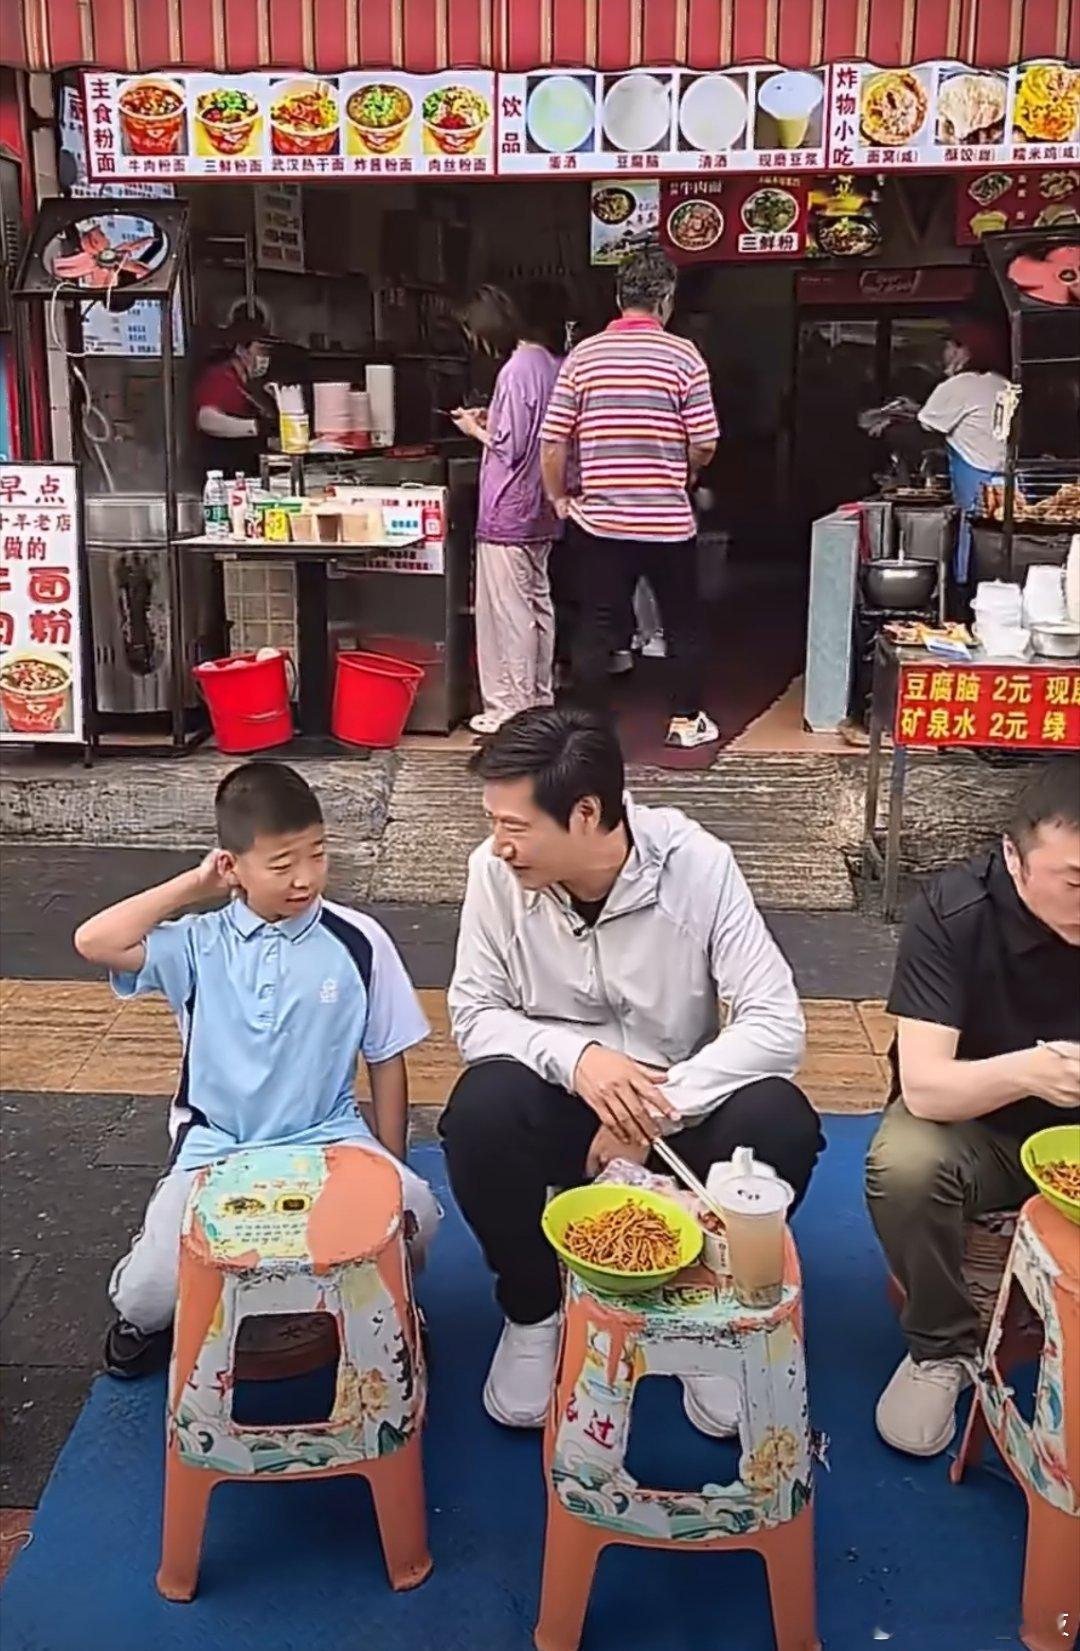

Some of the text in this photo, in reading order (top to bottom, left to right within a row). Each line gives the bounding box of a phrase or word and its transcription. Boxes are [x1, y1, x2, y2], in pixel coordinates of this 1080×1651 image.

[833, 67, 858, 166] 炸物小吃
[90, 78, 116, 174] 主食粉面
[501, 96, 522, 154] 饮品
[128, 158, 186, 173] 牛肉粉面
[204, 158, 263, 174] 三鲜粉面
[271, 157, 345, 172] 武汉热干面
[353, 157, 413, 173] 炸酱粉面
[428, 157, 488, 173] 肉丝粉面
[616, 154, 660, 169] 豆腐脑
[758, 152, 818, 168] 现磨豆浆
[741, 235, 794, 251] 三鲜粉
[0, 474, 65, 503] 早点
[5, 536, 46, 560] 做的
[903, 671, 982, 702] 豆腐脑
[991, 674, 1032, 704] 2元
[900, 706, 1067, 741] 矿泉水 2元 绿
